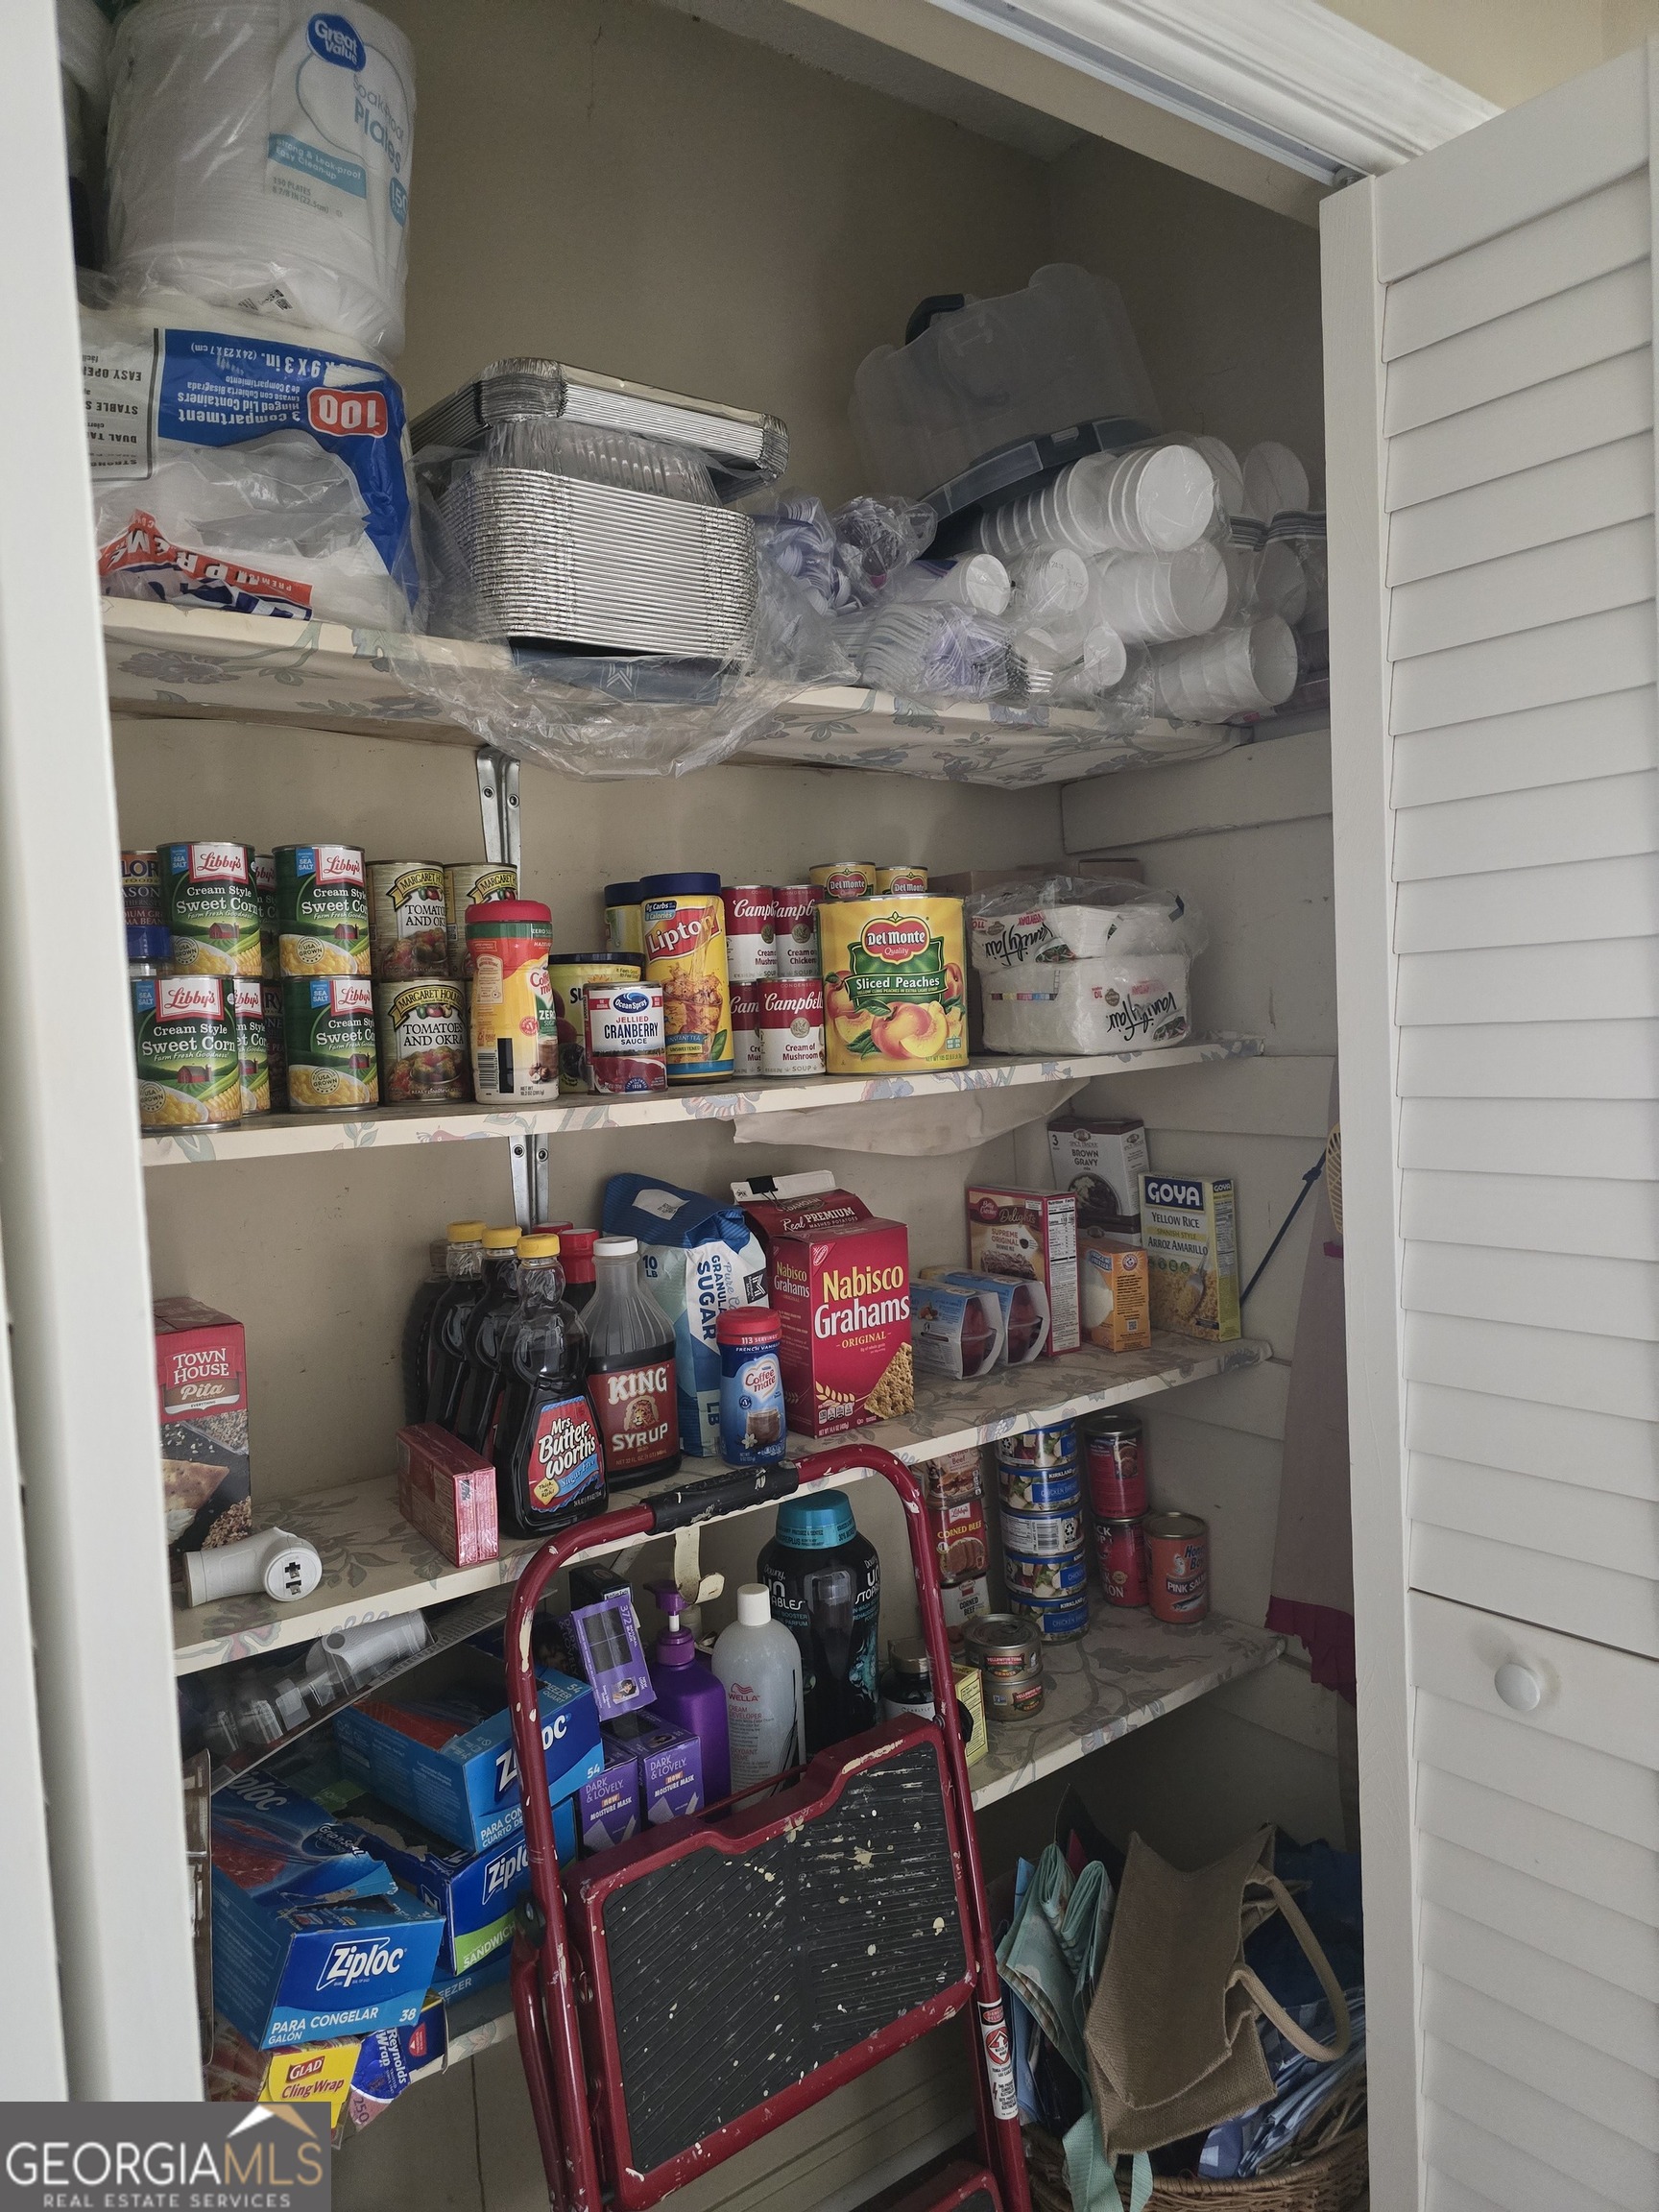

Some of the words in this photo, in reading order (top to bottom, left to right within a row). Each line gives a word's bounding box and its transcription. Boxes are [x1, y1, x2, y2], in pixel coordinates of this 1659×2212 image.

[315, 19, 357, 56] Great
[324, 38, 358, 65] Value
[354, 97, 401, 173] Plates
[96, 401, 138, 415] STABLE
[178, 392, 240, 410] Containers
[243, 398, 259, 411] Lid
[317, 394, 380, 430] 100
[108, 432, 138, 444] DUAL
[197, 852, 242, 872] Libby's
[323, 854, 361, 876] Libby's
[399, 874, 436, 889] MARGARET
[480, 875, 513, 889] MARGARET
[830, 880, 841, 889] Del
[842, 879, 865, 888] Monte
[186, 886, 226, 897] Cream
[228, 885, 252, 898] Style
[176, 897, 227, 914] Sweet
[230, 897, 258, 915] Corn
[301, 901, 349, 915] Sweet
[351, 901, 369, 914] Co
[405, 916, 432, 926] AND
[647, 914, 718, 954] Lipton
[868, 931, 886, 946] Del
[888, 931, 926, 945] Monte
[300, 948, 323, 956] GROWN
[884, 947, 909, 956] Quality
[856, 977, 891, 990] Sliced
[895, 976, 940, 989] Peaches
[163, 987, 216, 1008] Libby's
[397, 989, 438, 1008] MARGARET
[764, 993, 824, 1014] Campbell
[154, 1025, 196, 1037] Cream
[200, 1023, 228, 1035] Style
[328, 1020, 361, 1029] Cream
[403, 1023, 463, 1035] TOMATOES
[604, 1022, 659, 1039] CRANBERRY
[142, 1037, 198, 1056] Sweet
[207, 1036, 236, 1052] Corn
[316, 1032, 363, 1046] Sweet
[403, 1035, 432, 1046] AND
[434, 1034, 464, 1045] OKRA
[154, 1052, 172, 1062] Farm
[782, 1051, 818, 1061] Mushroom
[313, 1078, 338, 1088] GROWN
[1052, 1134, 1059, 1146] 3
[1071, 1149, 1099, 1158] BROWN
[1073, 1158, 1098, 1166] GRAVY
[1147, 1181, 1200, 1206] GOYA
[1214, 1183, 1231, 1192] GOYA
[804, 1206, 855, 1223] PREMIUM
[833, 1215, 858, 1226] POTATOES
[998, 1208, 1036, 1224] Delights
[1151, 1212, 1181, 1226] YELLOW
[1182, 1215, 1200, 1229] RICE
[783, 1215, 805, 1232] Real
[991, 1227, 1019, 1239] SUPREME
[991, 1235, 1020, 1246] ORIGINAL
[1147, 1237, 1173, 1250] ARROZ
[1173, 1240, 1208, 1256] AMARILLO
[643, 1256, 659, 1269] 10
[723, 1262, 735, 1295] Pure
[777, 1261, 807, 1283] Nabisco
[774, 1275, 810, 1298] Grahams
[822, 1265, 904, 1304] Nabisco
[697, 1261, 718, 1340] SUGAR
[814, 1296, 911, 1340] Grahams
[841, 1331, 887, 1349] ORIGINAL
[173, 1348, 227, 1370] TOWN
[174, 1363, 230, 1384] HOUSE
[745, 1369, 775, 1386] Coffee
[180, 1382, 225, 1401] Pita
[607, 1367, 667, 1406] KING
[754, 1375, 776, 1392] mate
[551, 1417, 573, 1436] Mrs.
[612, 1422, 668, 1453] SYRUP
[561, 1469, 582, 1488] Sugar
[580, 1457, 595, 1474] Free
[1048, 1469, 1073, 1479] KIRKLAND
[937, 1525, 968, 1539] CORNED
[968, 1521, 982, 1530] BEEF
[1167, 1580, 1188, 1593] PINK
[960, 1597, 979, 1610] CORNED
[964, 1605, 975, 1616] BEEF
[1060, 1598, 1083, 1609] KIRKLAND
[619, 1604, 632, 1626] 372
[566, 1683, 583, 1694] 54
[728, 1693, 758, 1702] WELLA
[587, 1763, 601, 1779] 54
[651, 1755, 672, 1771] DARK
[651, 1770, 657, 1780] &
[586, 1777, 607, 1793] DARK
[655, 1782, 680, 1797] MOISTURE
[680, 1774, 695, 1788] MASK
[586, 1793, 593, 1803] &
[589, 1803, 616, 1820] MOISTURE
[616, 1796, 632, 1811] MASK
[480, 1819, 503, 1841] PARA
[463, 1920, 517, 1970] SANDWICH
[326, 1943, 404, 1988] Ziploc
[271, 2018, 306, 2035] PARA
[309, 2007, 379, 2029] CONGELAR
[399, 2008, 417, 2023] 38
[268, 2030, 303, 2045] GALÓN
[376, 2030, 392, 2068] Wrap
[386, 2026, 407, 2085] Reynolds
[289, 2058, 324, 2080] GLAD
[281, 2080, 311, 2099] Cling
[313, 2079, 345, 2094] Wrap
[353, 2096, 371, 2124] 250
